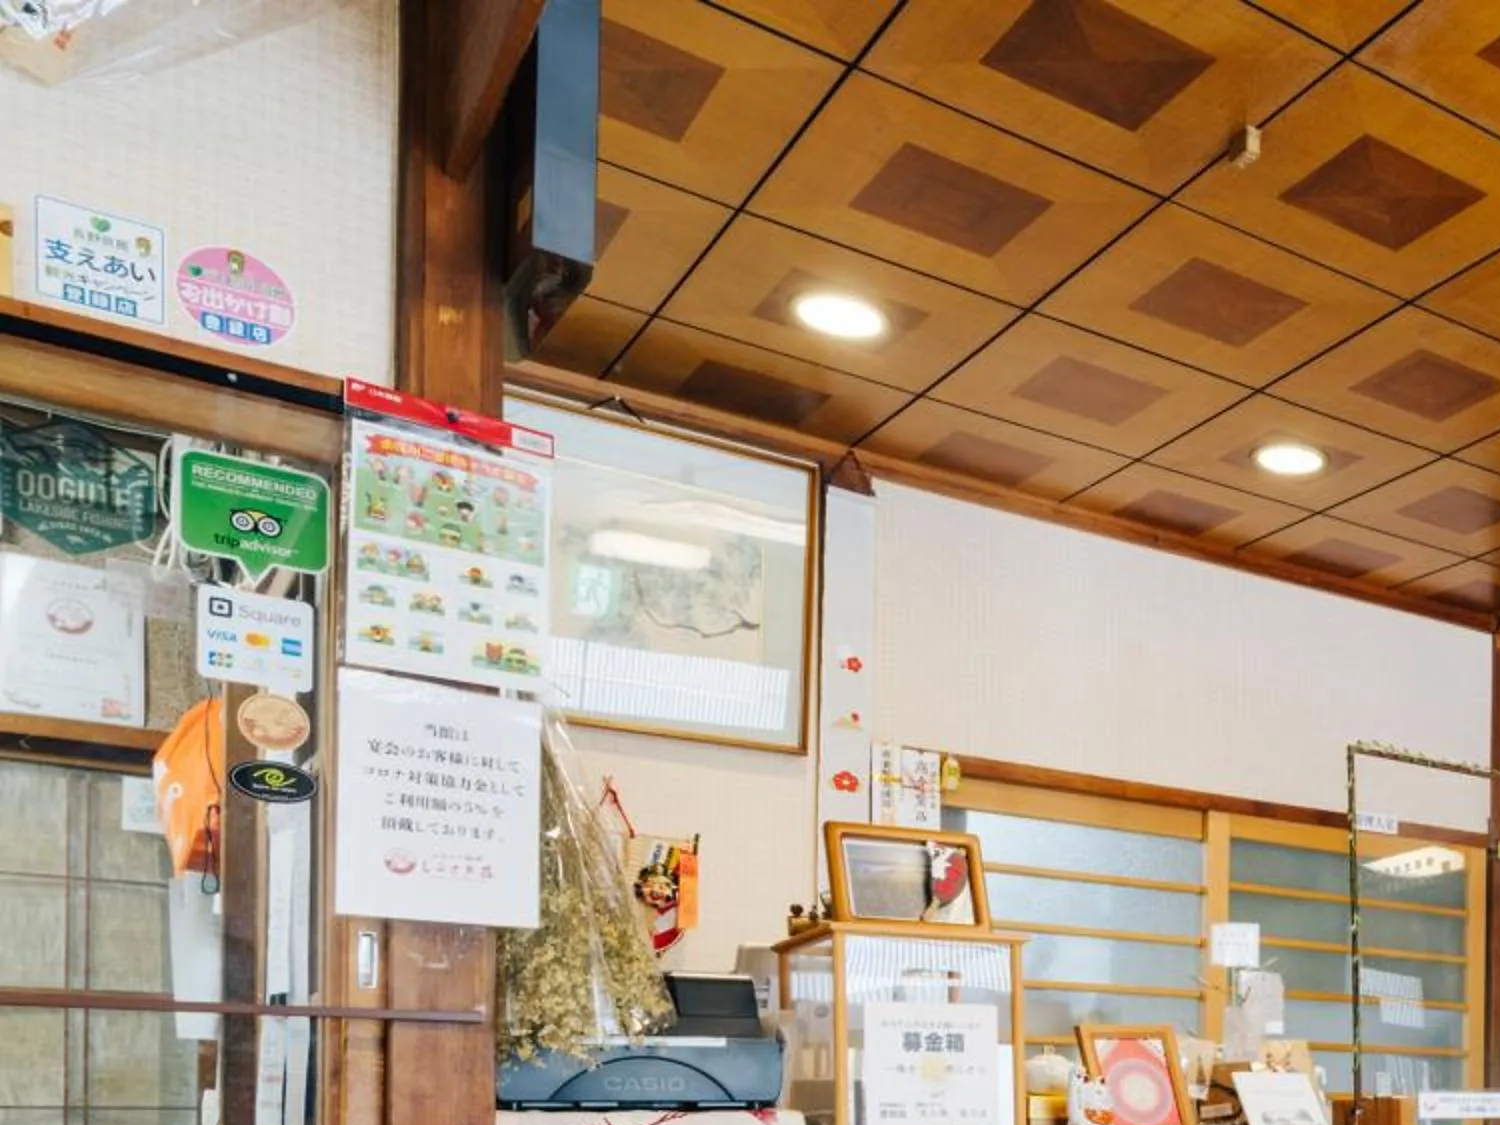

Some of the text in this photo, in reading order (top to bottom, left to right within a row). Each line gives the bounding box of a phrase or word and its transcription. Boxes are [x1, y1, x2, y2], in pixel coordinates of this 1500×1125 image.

[45, 237, 156, 282] 支えあい
[191, 463, 317, 500] RECOMMENDED
[213, 532, 294, 558] tripadvisor
[239, 605, 301, 627] Square
[207, 629, 237, 642] VISA
[368, 738, 521, 774] 宴会のお客様に対して
[903, 1031, 965, 1053] 募金箱
[604, 1077, 685, 1091] CASIO
